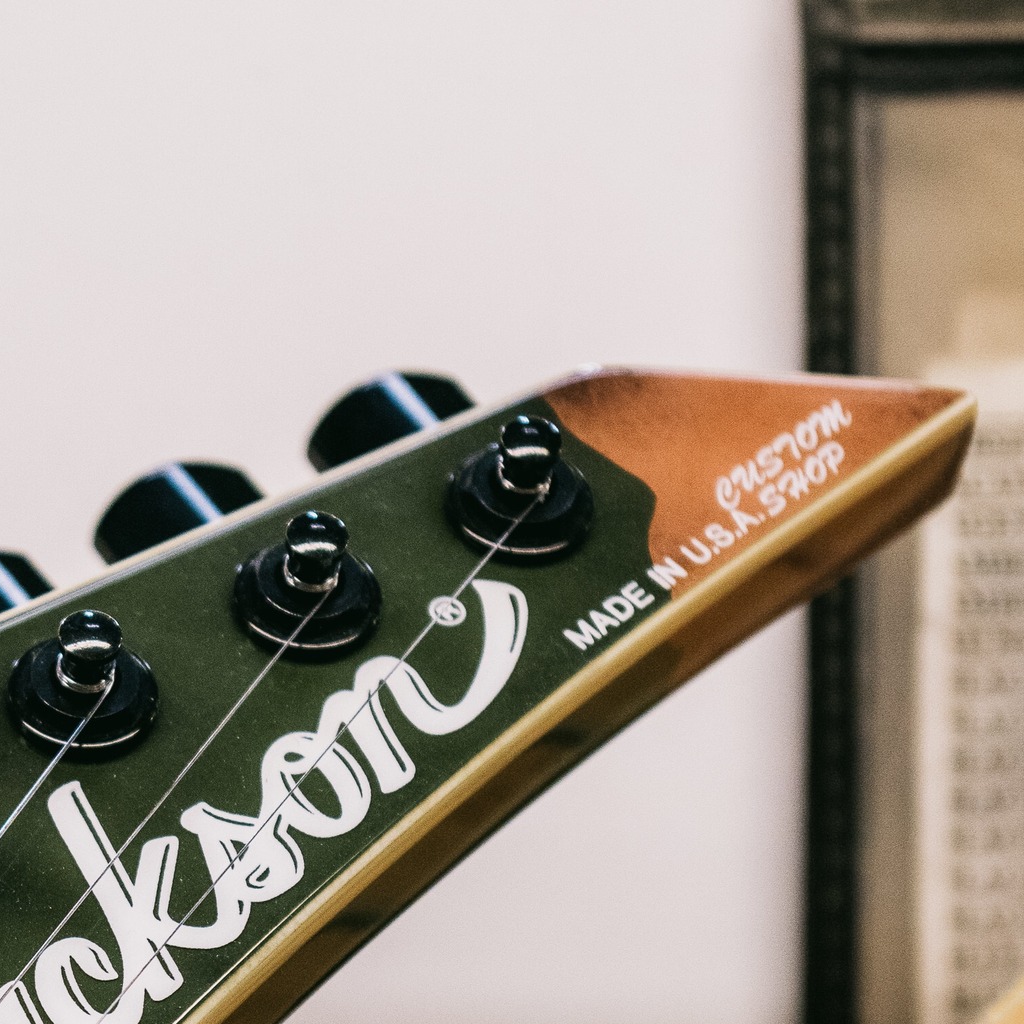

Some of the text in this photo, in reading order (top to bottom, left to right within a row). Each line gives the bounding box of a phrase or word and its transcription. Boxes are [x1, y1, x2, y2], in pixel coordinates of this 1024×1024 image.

[715, 400, 852, 510] CUSTOM
[758, 441, 845, 516] SHOP
[562, 508, 767, 651] MADE IN U.S.A.
